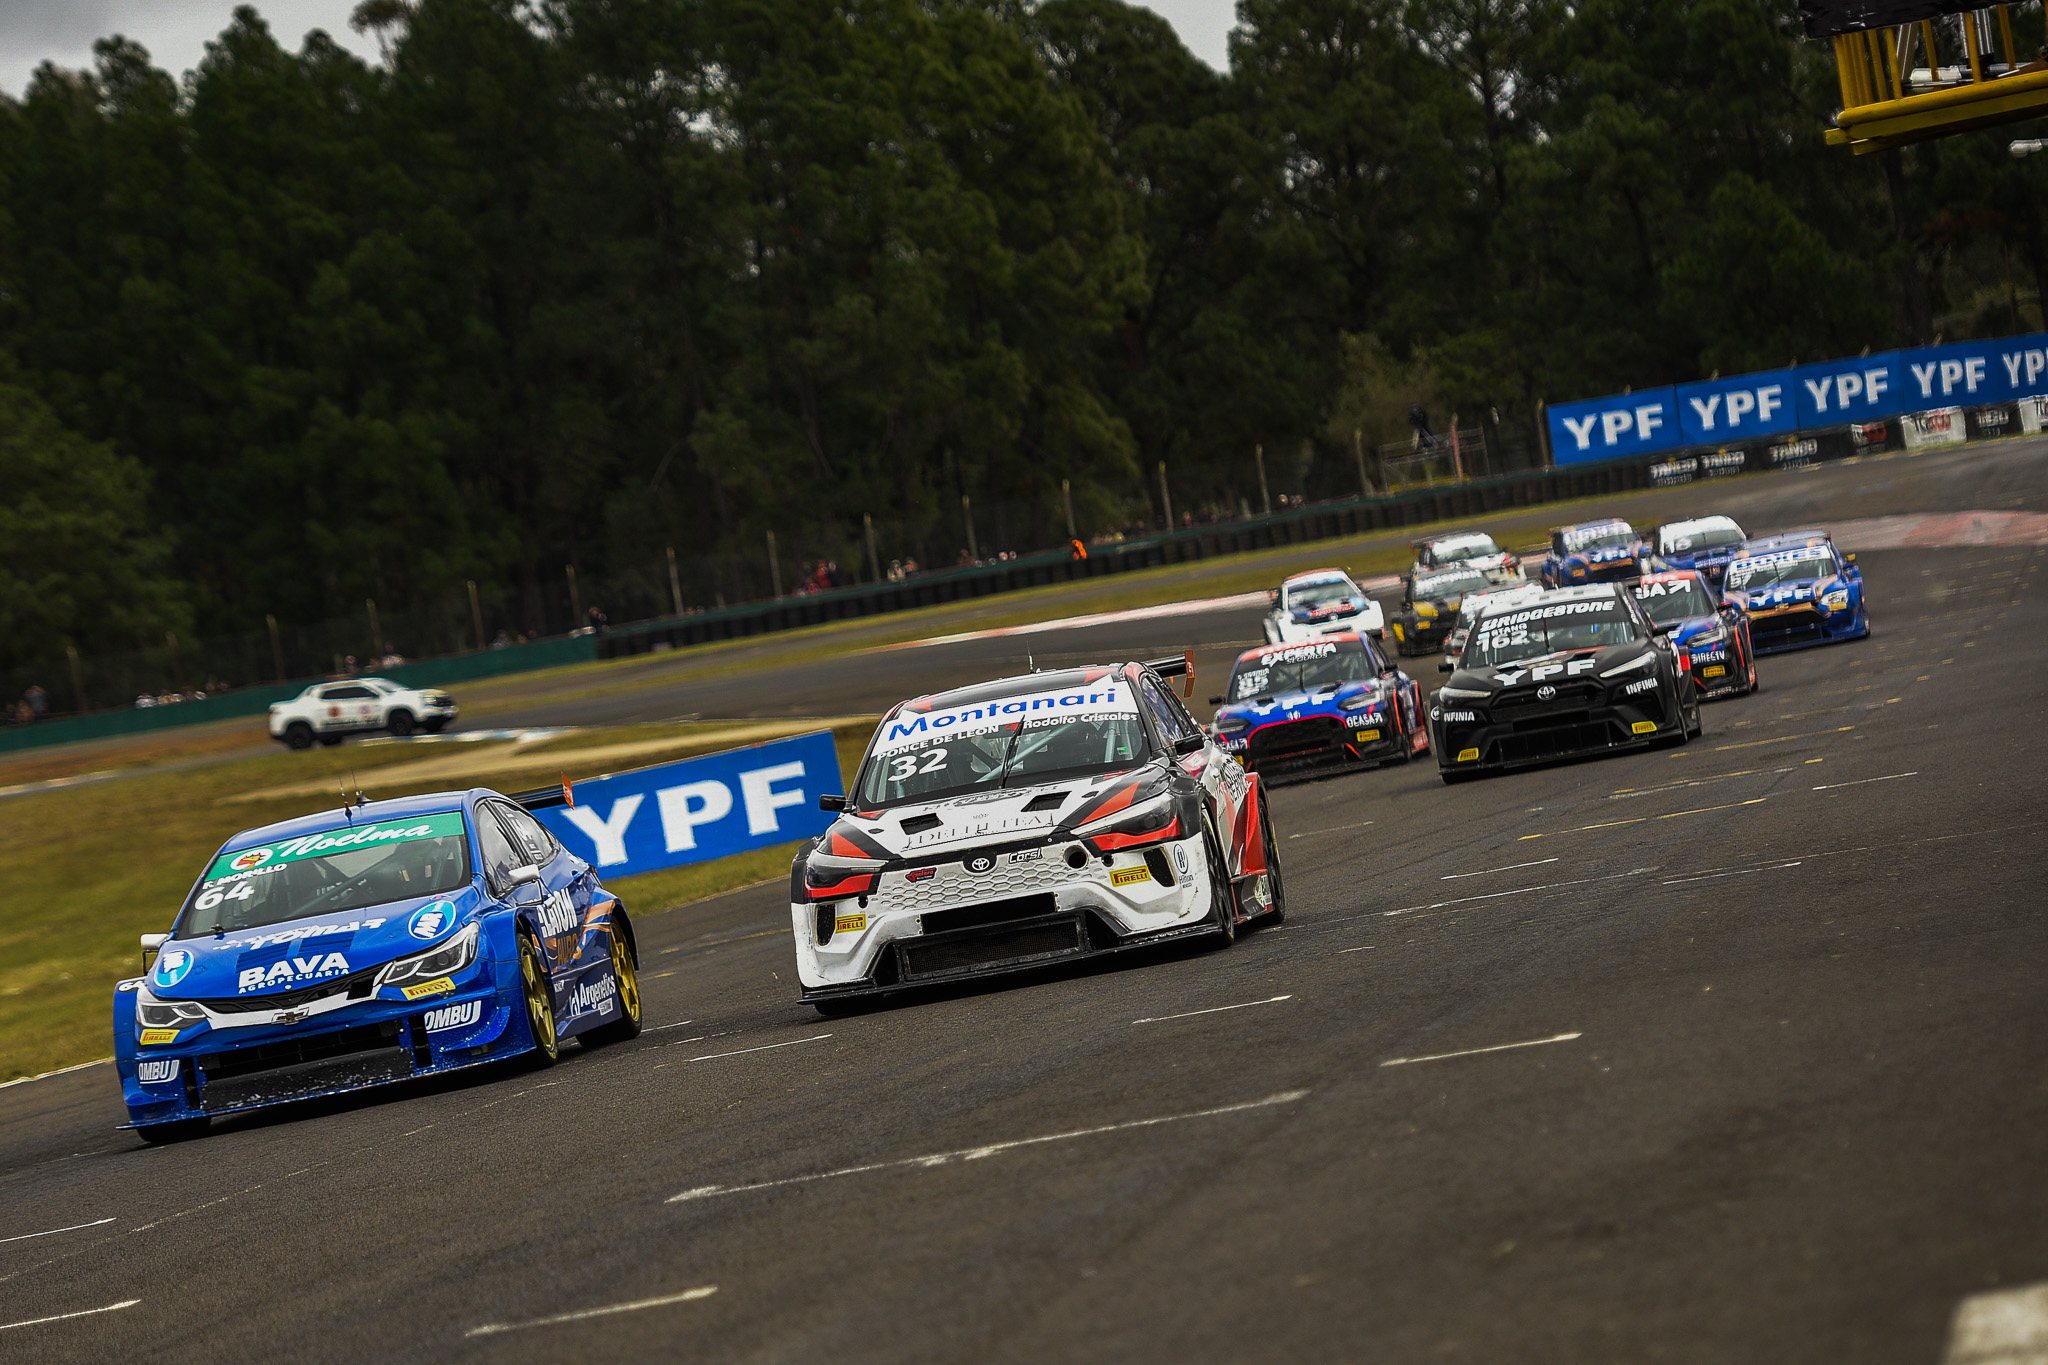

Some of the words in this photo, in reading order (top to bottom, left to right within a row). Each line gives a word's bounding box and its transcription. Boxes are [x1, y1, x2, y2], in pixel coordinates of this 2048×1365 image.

[1911, 356, 1986, 398] YPF
[2001, 346, 2048, 388] YP
[1805, 367, 1889, 413] YPF
[1690, 384, 1782, 431] YPF
[1563, 403, 1664, 450] YPF
[1751, 588, 1813, 607] YPF
[1481, 600, 1616, 632] BRIDGESTONE
[1476, 630, 1530, 652] 162
[1261, 643, 1337, 667] EXPERTA
[1691, 650, 1725, 664] DIRECTV
[1494, 659, 1596, 686] YPF
[1626, 677, 1658, 695] INFINIA
[888, 688, 1116, 742] Montanari
[1253, 693, 1336, 716] YPF
[1443, 711, 1475, 722] INFINIA
[1023, 714, 1077, 730] Rodolfo
[1081, 711, 1138, 723] Cristales
[877, 741, 929, 762] PONCE
[933, 735, 954, 746] DE
[887, 748, 949, 782] 32
[560, 760, 806, 867] YPF
[277, 824, 433, 858] Noelma
[202, 880, 215, 890] F.
[216, 863, 288, 887] MORILLO
[1114, 868, 1148, 884] PIRELLI
[194, 881, 255, 911] 64
[836, 916, 864, 931] PIRELLI
[238, 952, 350, 988] BAVA
[238, 968, 350, 994] AGROPECUARIA
[407, 980, 449, 996] PIRELLI
[142, 1031, 174, 1042] PIRELLI
